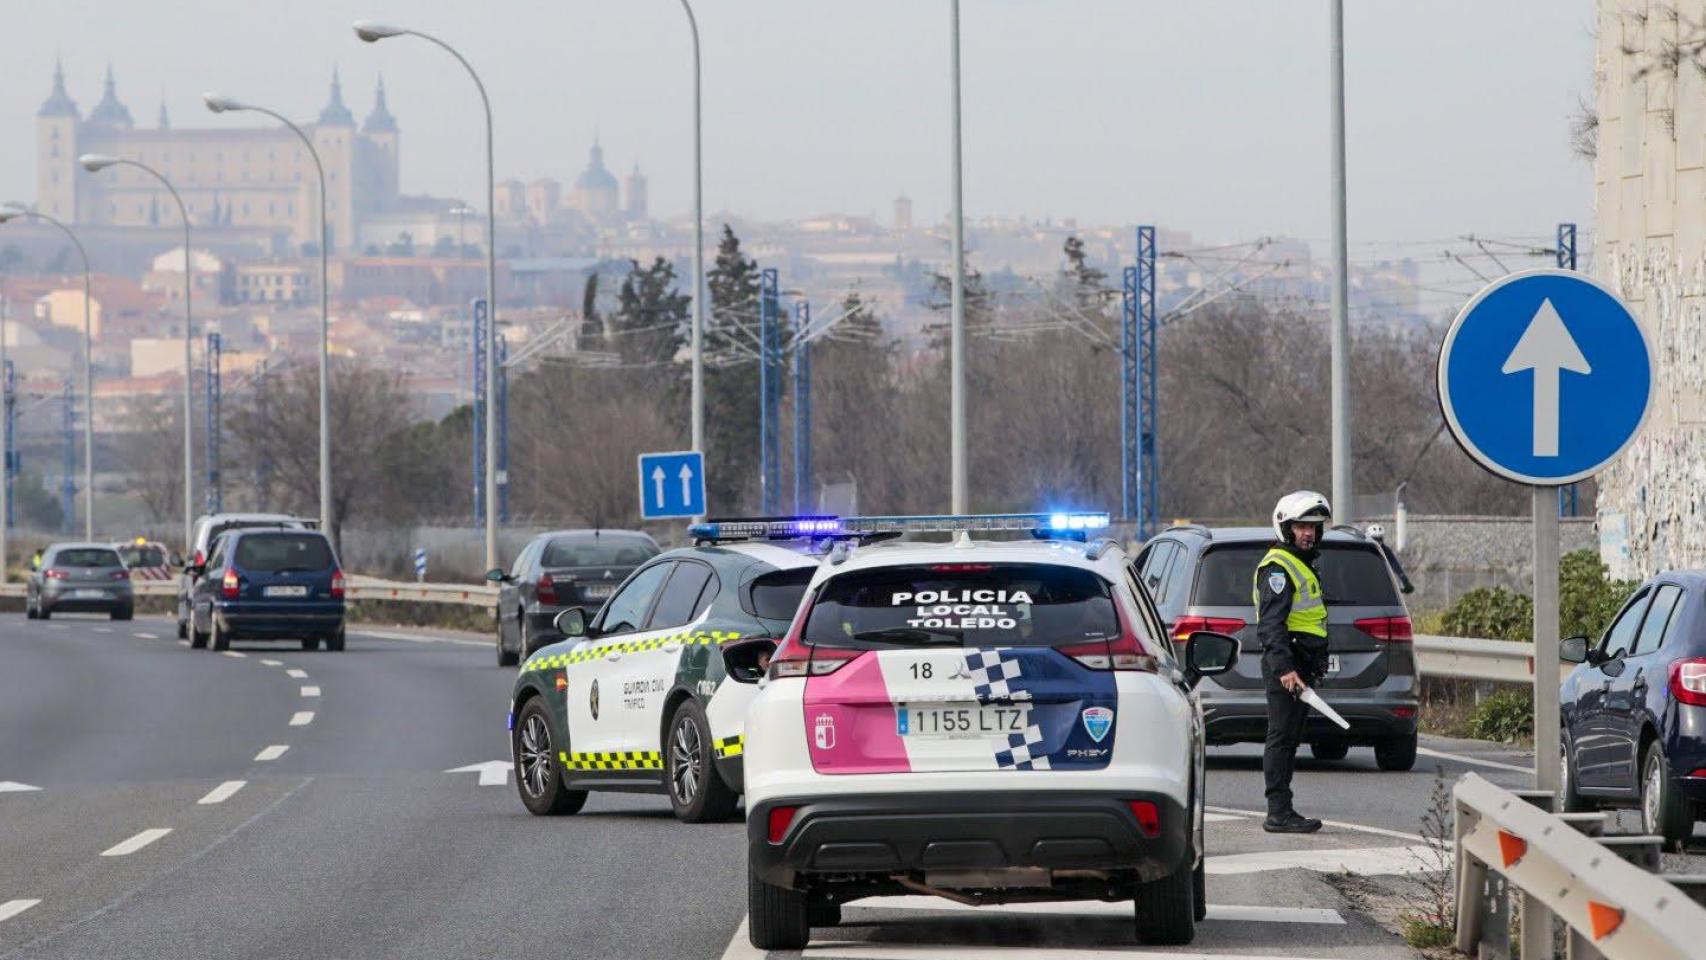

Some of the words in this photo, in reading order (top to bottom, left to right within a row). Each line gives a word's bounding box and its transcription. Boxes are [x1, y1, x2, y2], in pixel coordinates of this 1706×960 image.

[891, 590, 1033, 605] POLICIA
[917, 605, 1007, 616] LOCAL
[906, 618, 1016, 629] TOLEDO
[910, 662, 933, 679] 18
[624, 681, 649, 694] GUARDIA
[917, 710, 970, 731] 1155
[979, 709, 1022, 730] LTZ
